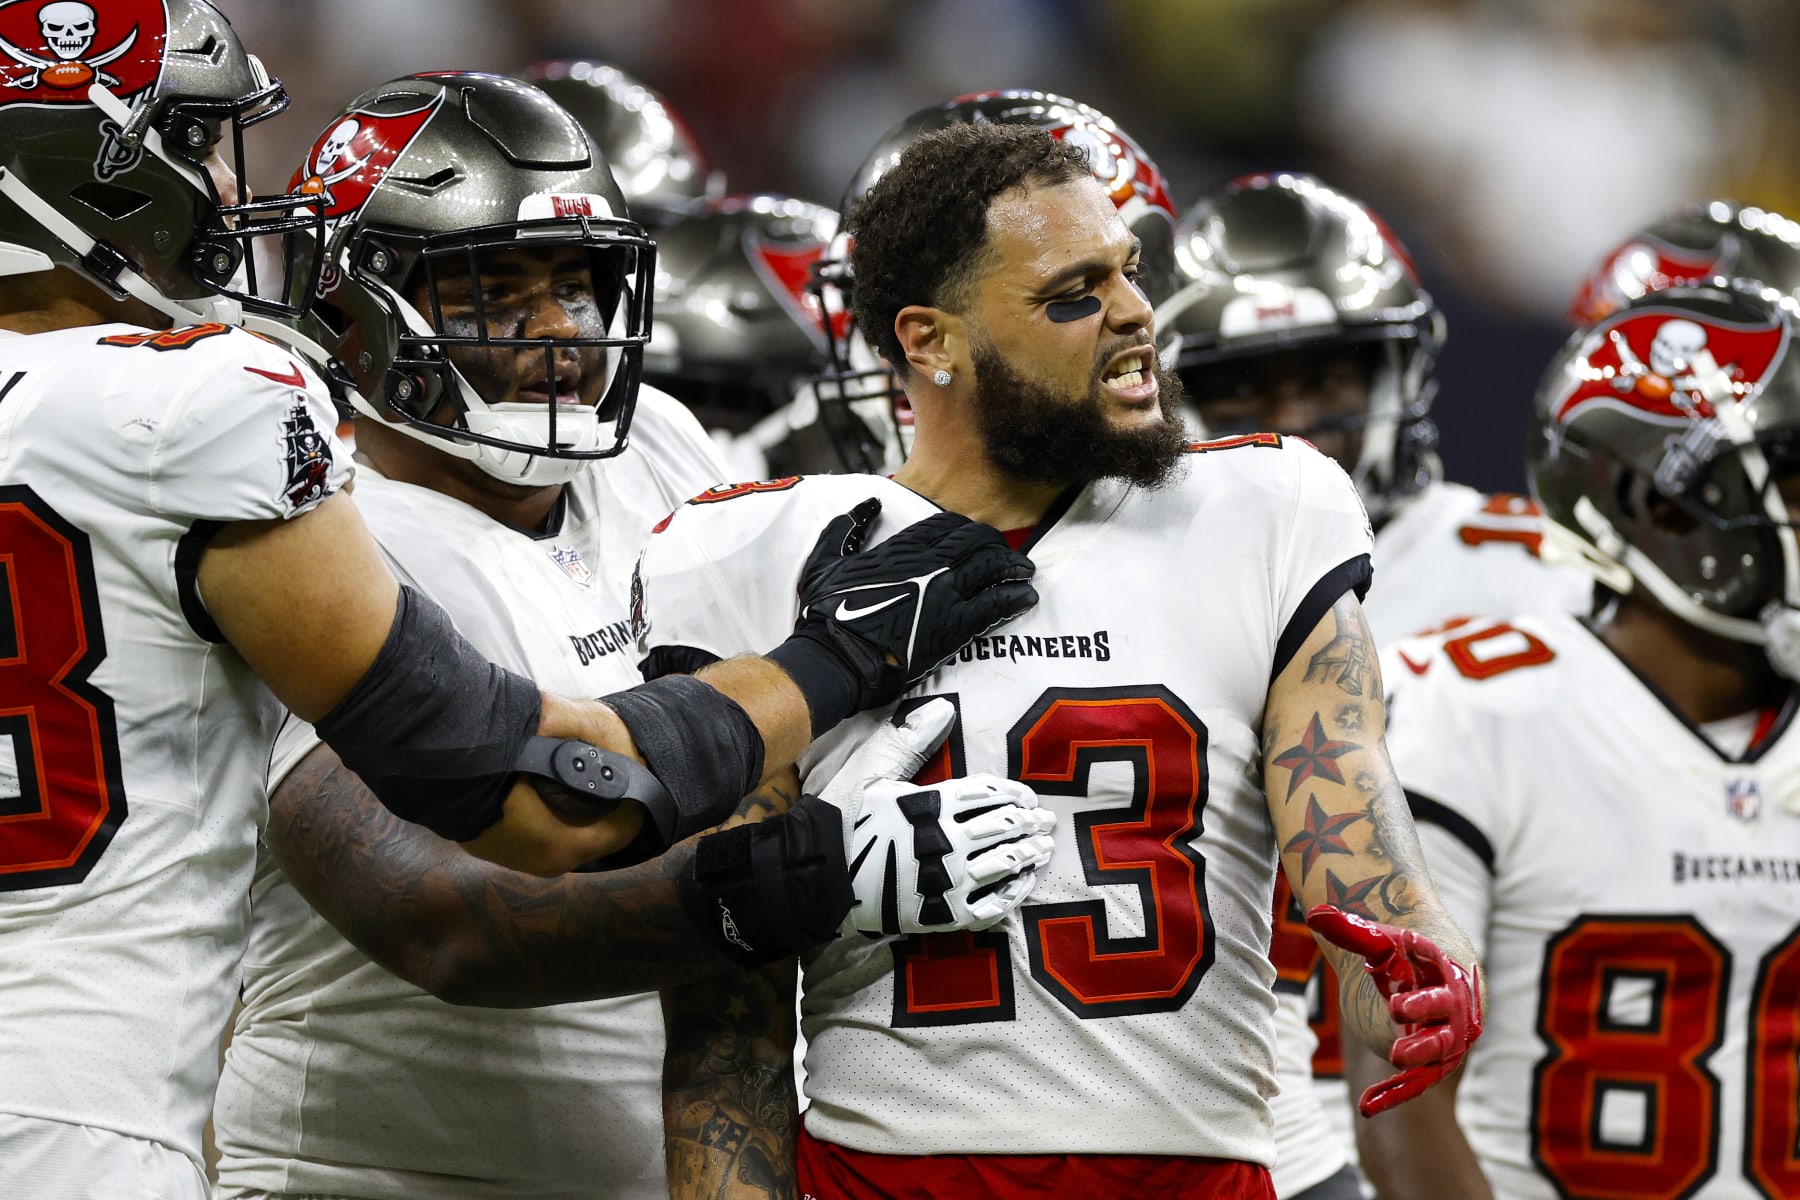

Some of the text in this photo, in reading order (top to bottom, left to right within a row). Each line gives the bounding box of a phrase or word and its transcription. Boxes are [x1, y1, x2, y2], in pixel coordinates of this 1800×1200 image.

[568, 618, 634, 667] BUCCAN
[944, 630, 1111, 667] UCCANEERS
[1672, 851, 1800, 885] BUCCANEE
[1528, 913, 1800, 1200] 8
